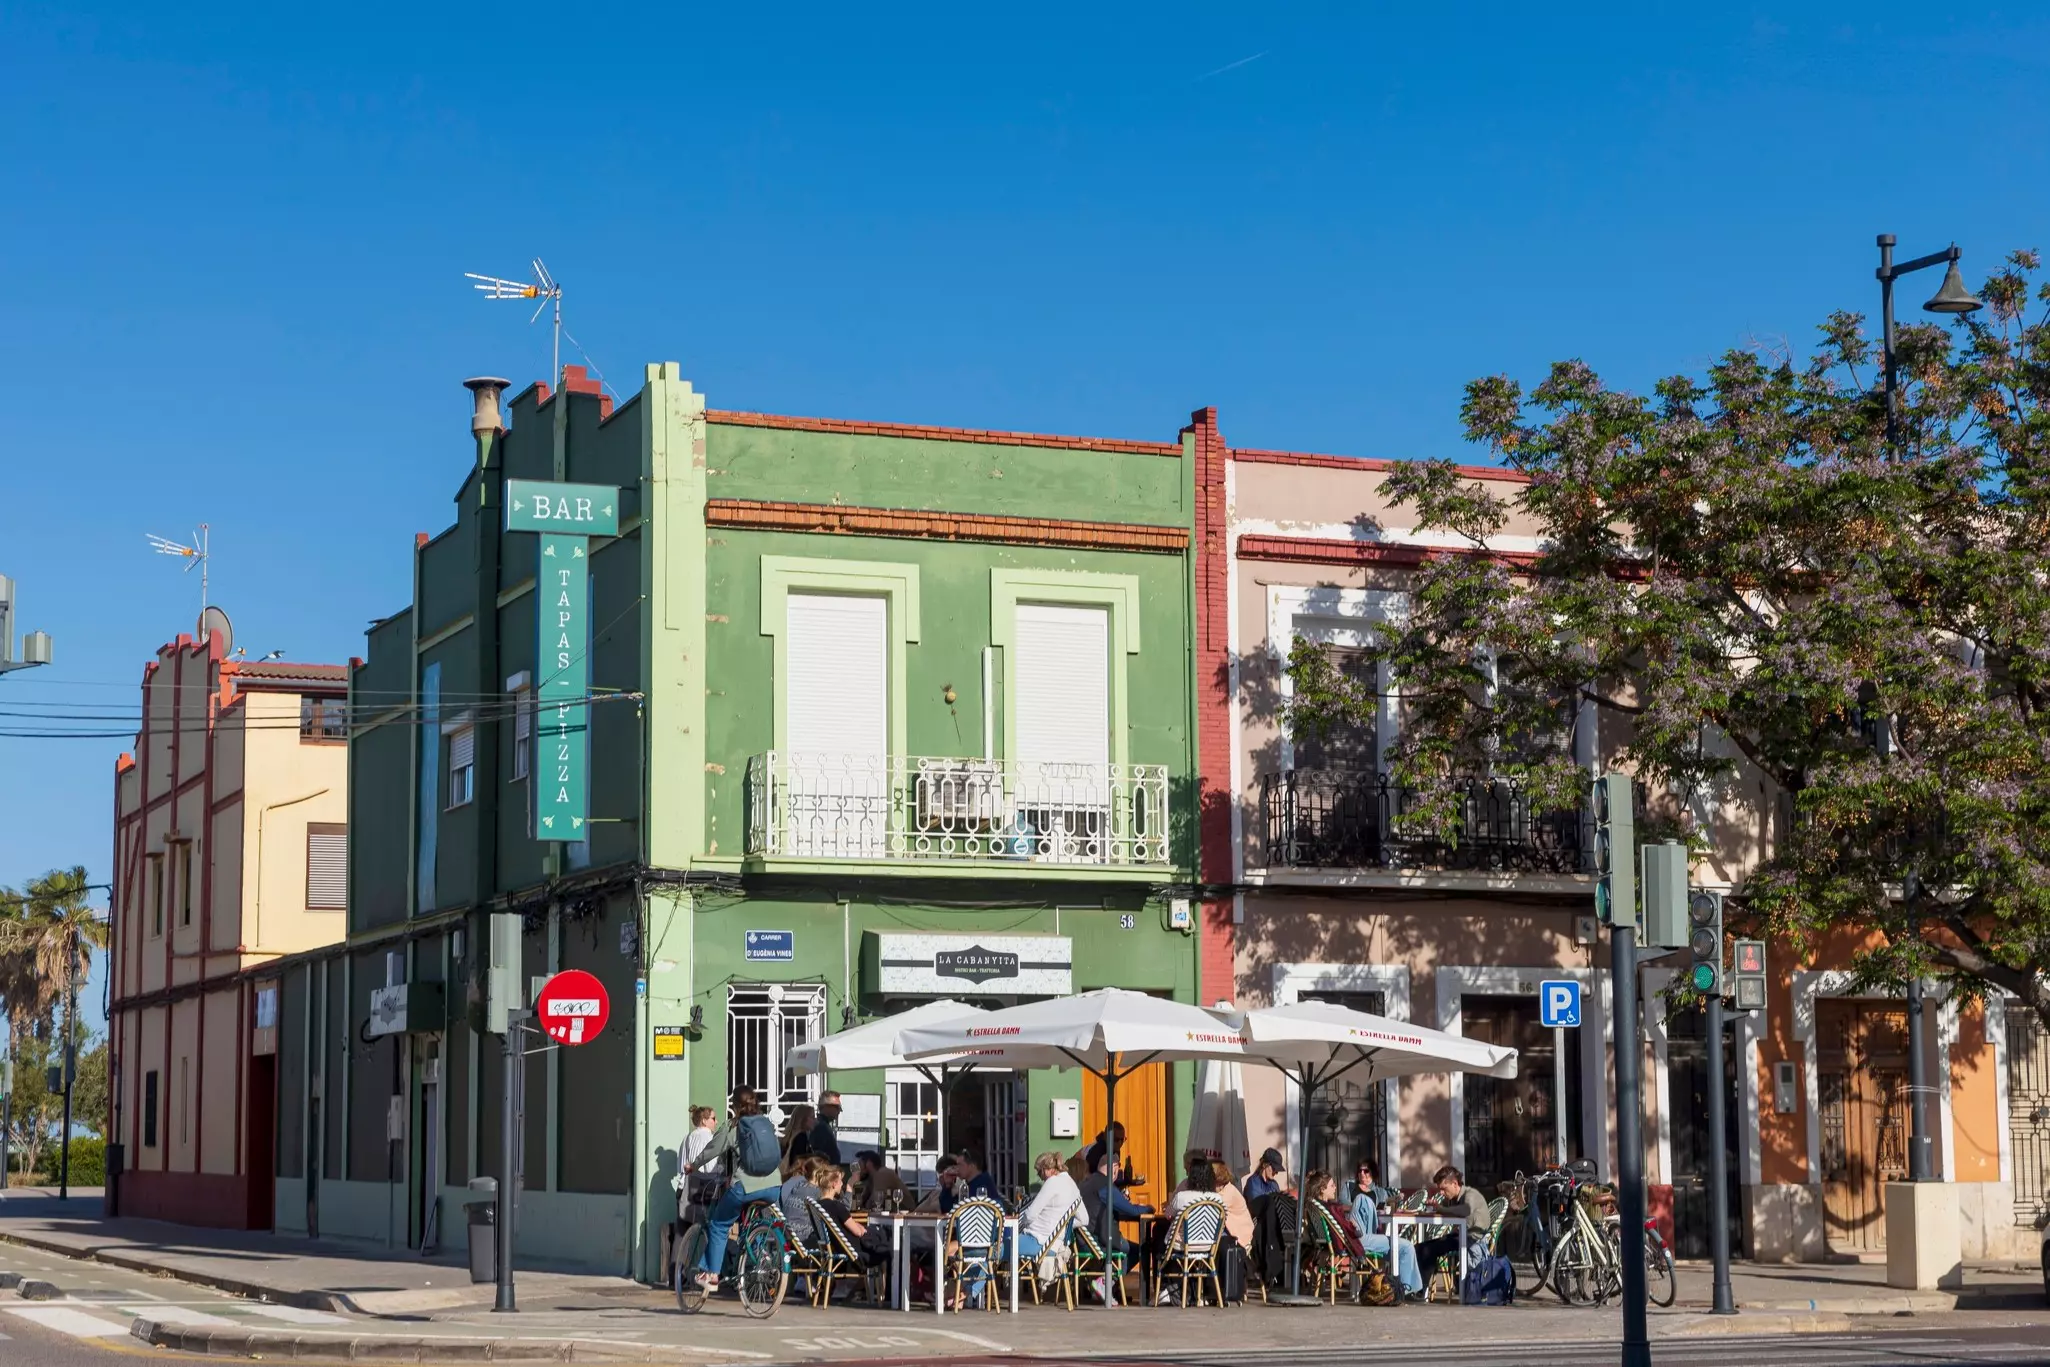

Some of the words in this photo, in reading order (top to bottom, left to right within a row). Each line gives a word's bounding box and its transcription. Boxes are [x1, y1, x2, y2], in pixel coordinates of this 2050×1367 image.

[532, 495, 594, 521] BAR
[557, 569, 571, 669] TAPAS
[556, 702, 571, 803] PIZZA
[1120, 914, 1135, 929] 58
[939, 955, 951, 964] LA
[956, 955, 1016, 965] CABANYITA
[1519, 982, 1533, 993] 56
[1549, 986, 1573, 1021] P
[973, 1027, 1001, 1037] ESTRELLA
[1001, 1026, 1021, 1035] DAMM
[1360, 1029, 1397, 1041] ESTRELLA
[1398, 1035, 1422, 1046] DAMM
[1195, 1033, 1227, 1044] ESTRELLA
[1227, 1035, 1248, 1046] DAMM
[780, 1336, 922, 1351] SOLO
